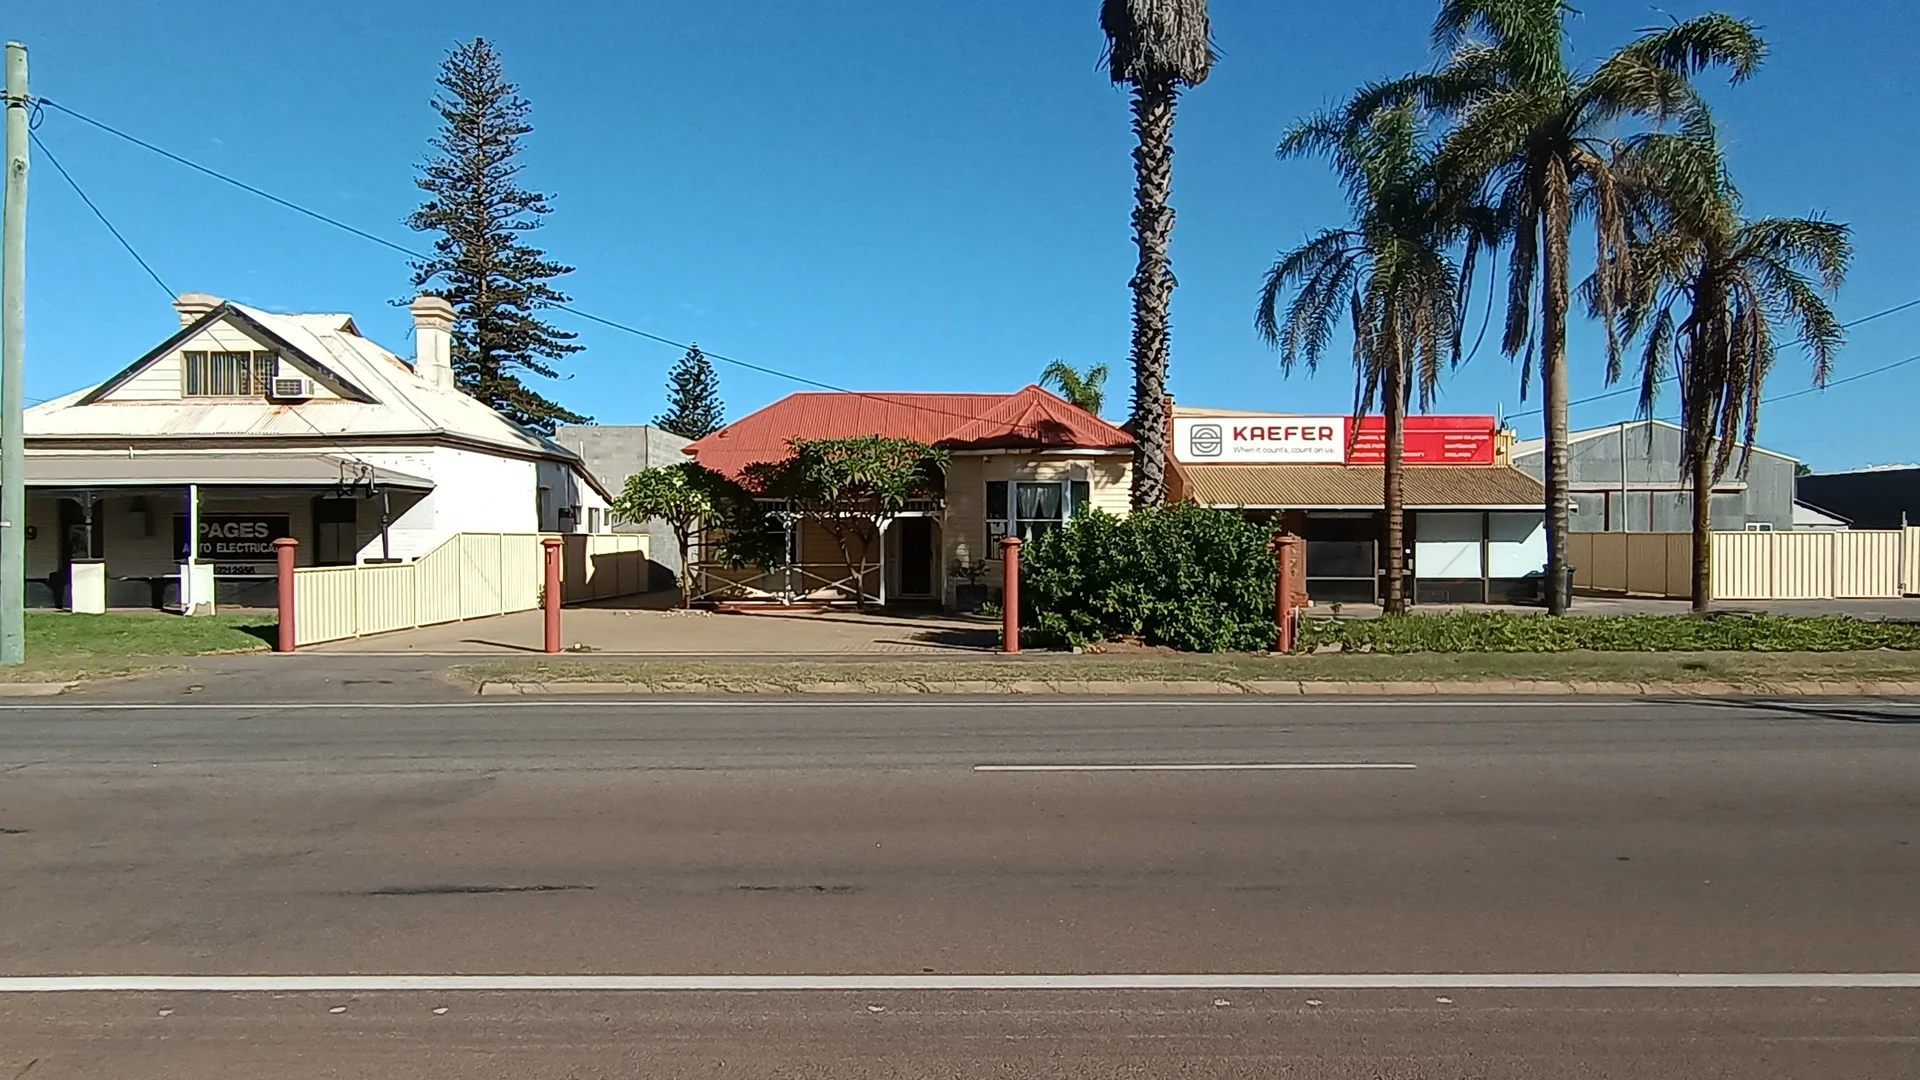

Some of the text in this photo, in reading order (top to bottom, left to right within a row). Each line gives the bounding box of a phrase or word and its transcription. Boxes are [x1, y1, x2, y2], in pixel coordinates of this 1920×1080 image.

[1233, 426, 1333, 441] KAEFER
[1233, 446, 1254, 454] When
[199, 521, 269, 539] PAGES
[182, 542, 212, 554] ATO
